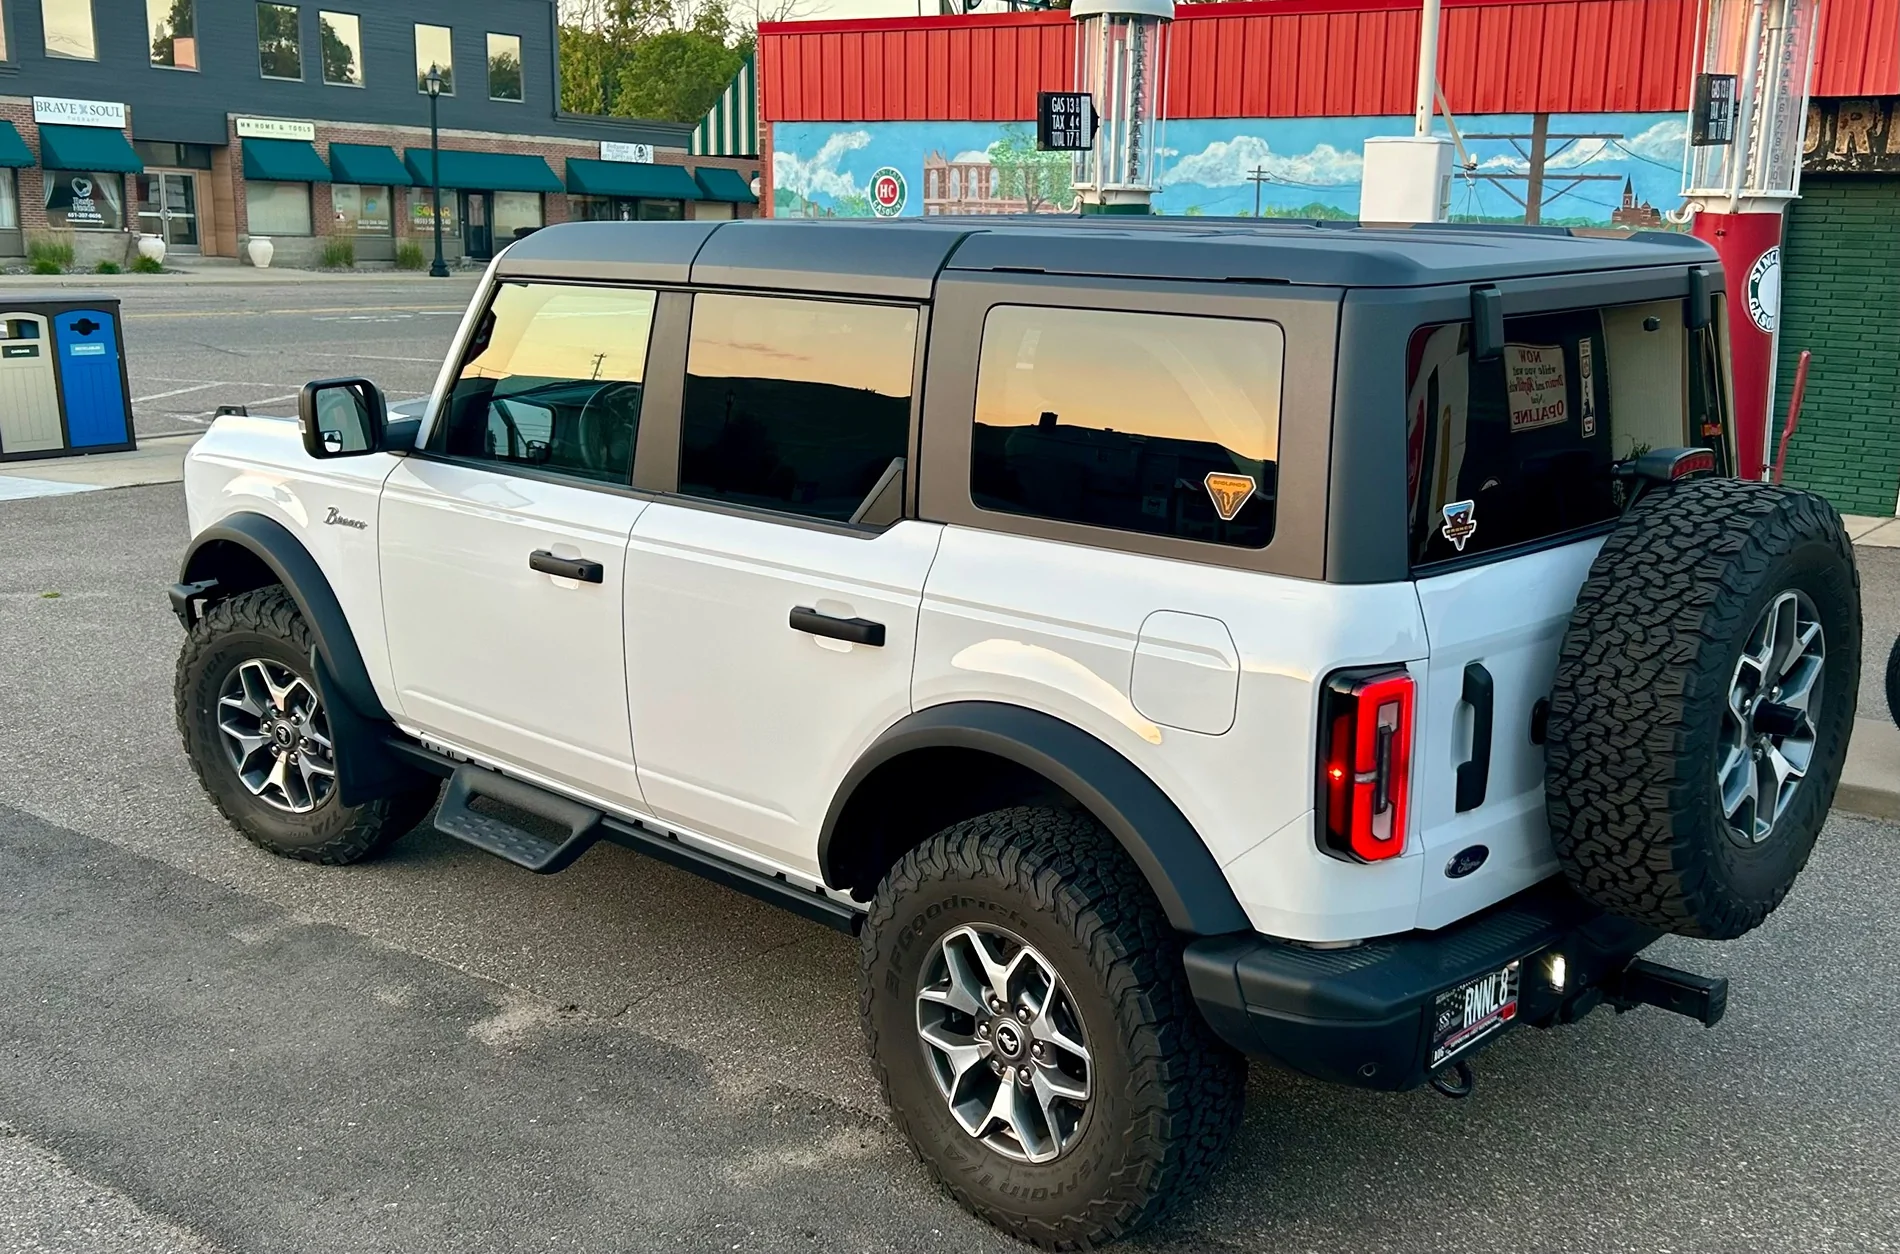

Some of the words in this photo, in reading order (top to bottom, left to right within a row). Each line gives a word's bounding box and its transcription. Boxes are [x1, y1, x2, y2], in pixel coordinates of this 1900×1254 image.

[35, 100, 78, 115] BRAVE
[89, 104, 123, 118] SOUL
[1051, 96, 1065, 113] GAS
[1066, 97, 1075, 113] 13
[255, 122, 274, 130] HOME
[1051, 114, 1065, 130] TAX
[1066, 131, 1075, 147] 17
[880, 184, 895, 198] HC
[323, 506, 368, 530] Bronco
[1463, 974, 1499, 1029] RNNL
[1499, 967, 1509, 1006] 8
